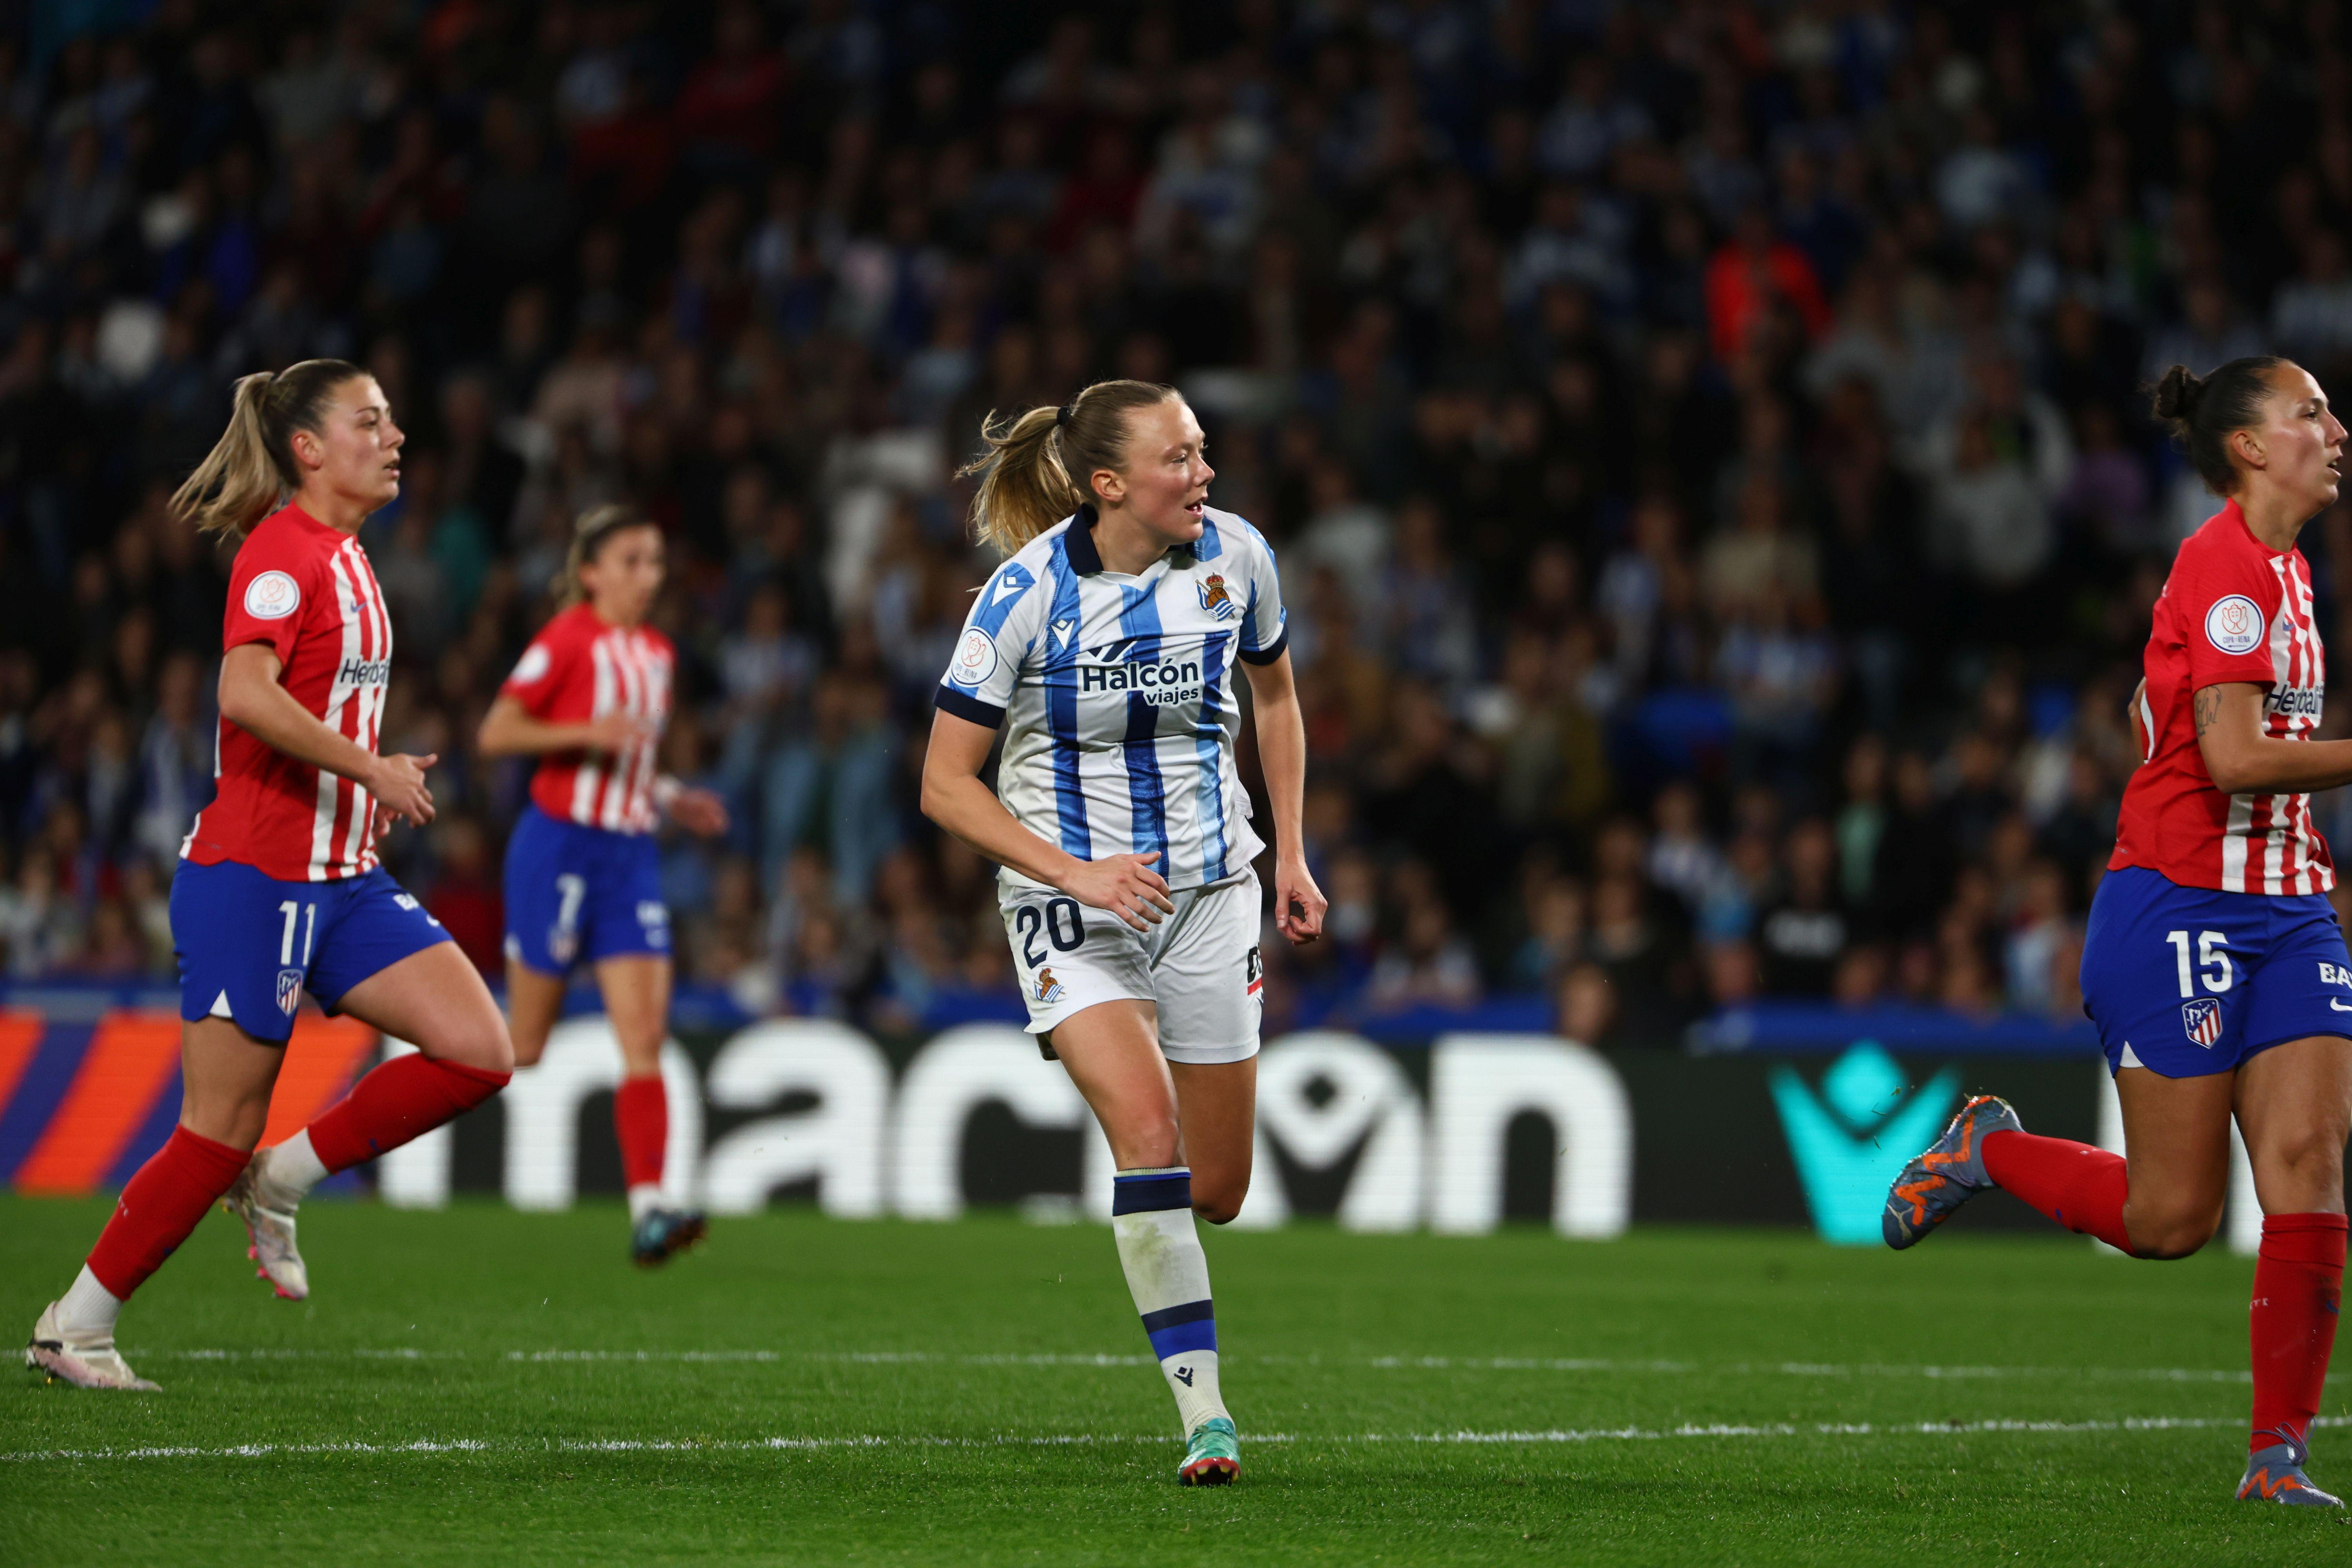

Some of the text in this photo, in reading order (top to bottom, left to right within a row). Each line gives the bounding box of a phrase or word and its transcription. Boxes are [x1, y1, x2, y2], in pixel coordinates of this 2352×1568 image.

[1083, 658, 1199, 691] Halcón
[1146, 686, 1198, 705] viajes
[279, 900, 316, 965] 11
[1016, 897, 1085, 969] 20
[2166, 930, 2233, 998] 15
